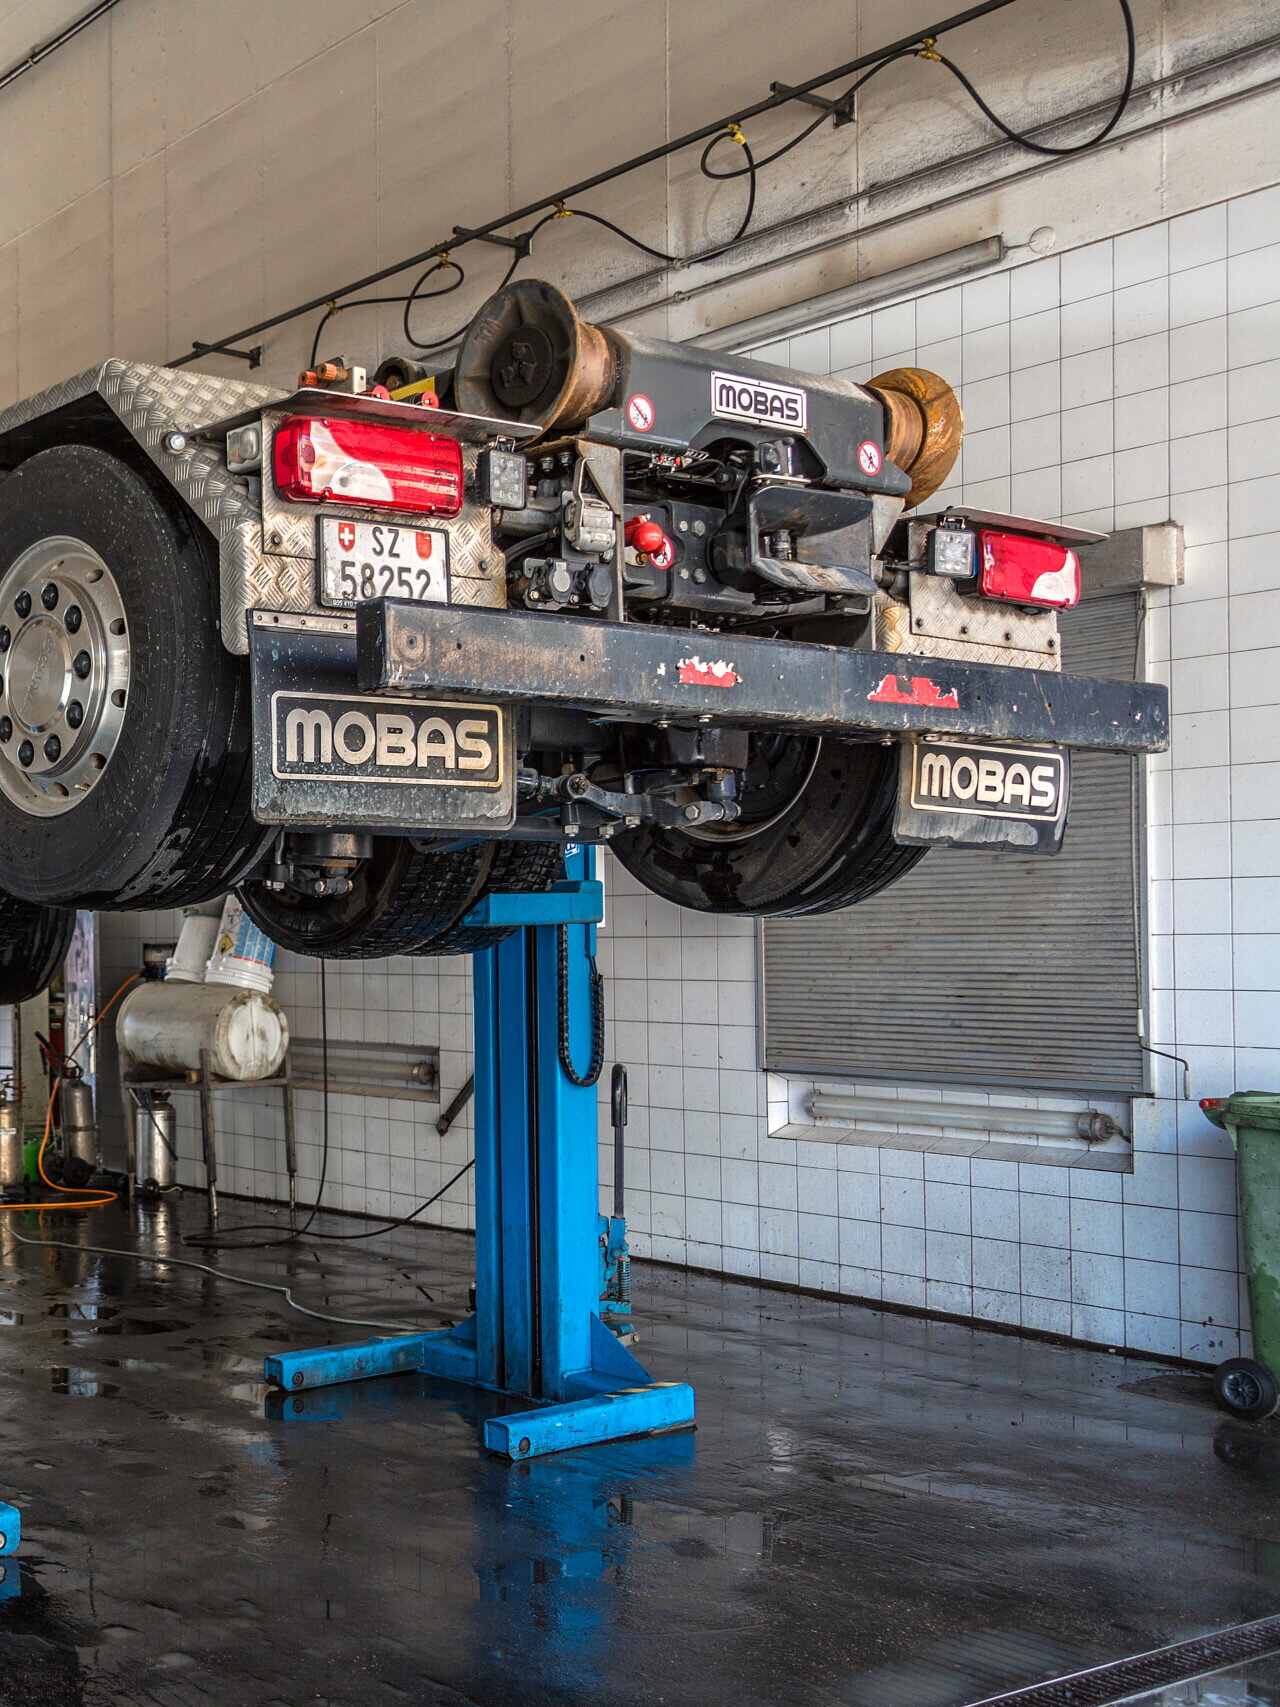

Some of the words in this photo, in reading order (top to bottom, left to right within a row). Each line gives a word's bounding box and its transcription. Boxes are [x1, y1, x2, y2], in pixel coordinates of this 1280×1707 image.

[719, 383, 799, 421] MOBAS
[372, 526, 400, 558] SZ
[340, 560, 431, 600] 58252
[286, 708, 492, 770] MOBAS
[920, 753, 1056, 807] MOBAS
